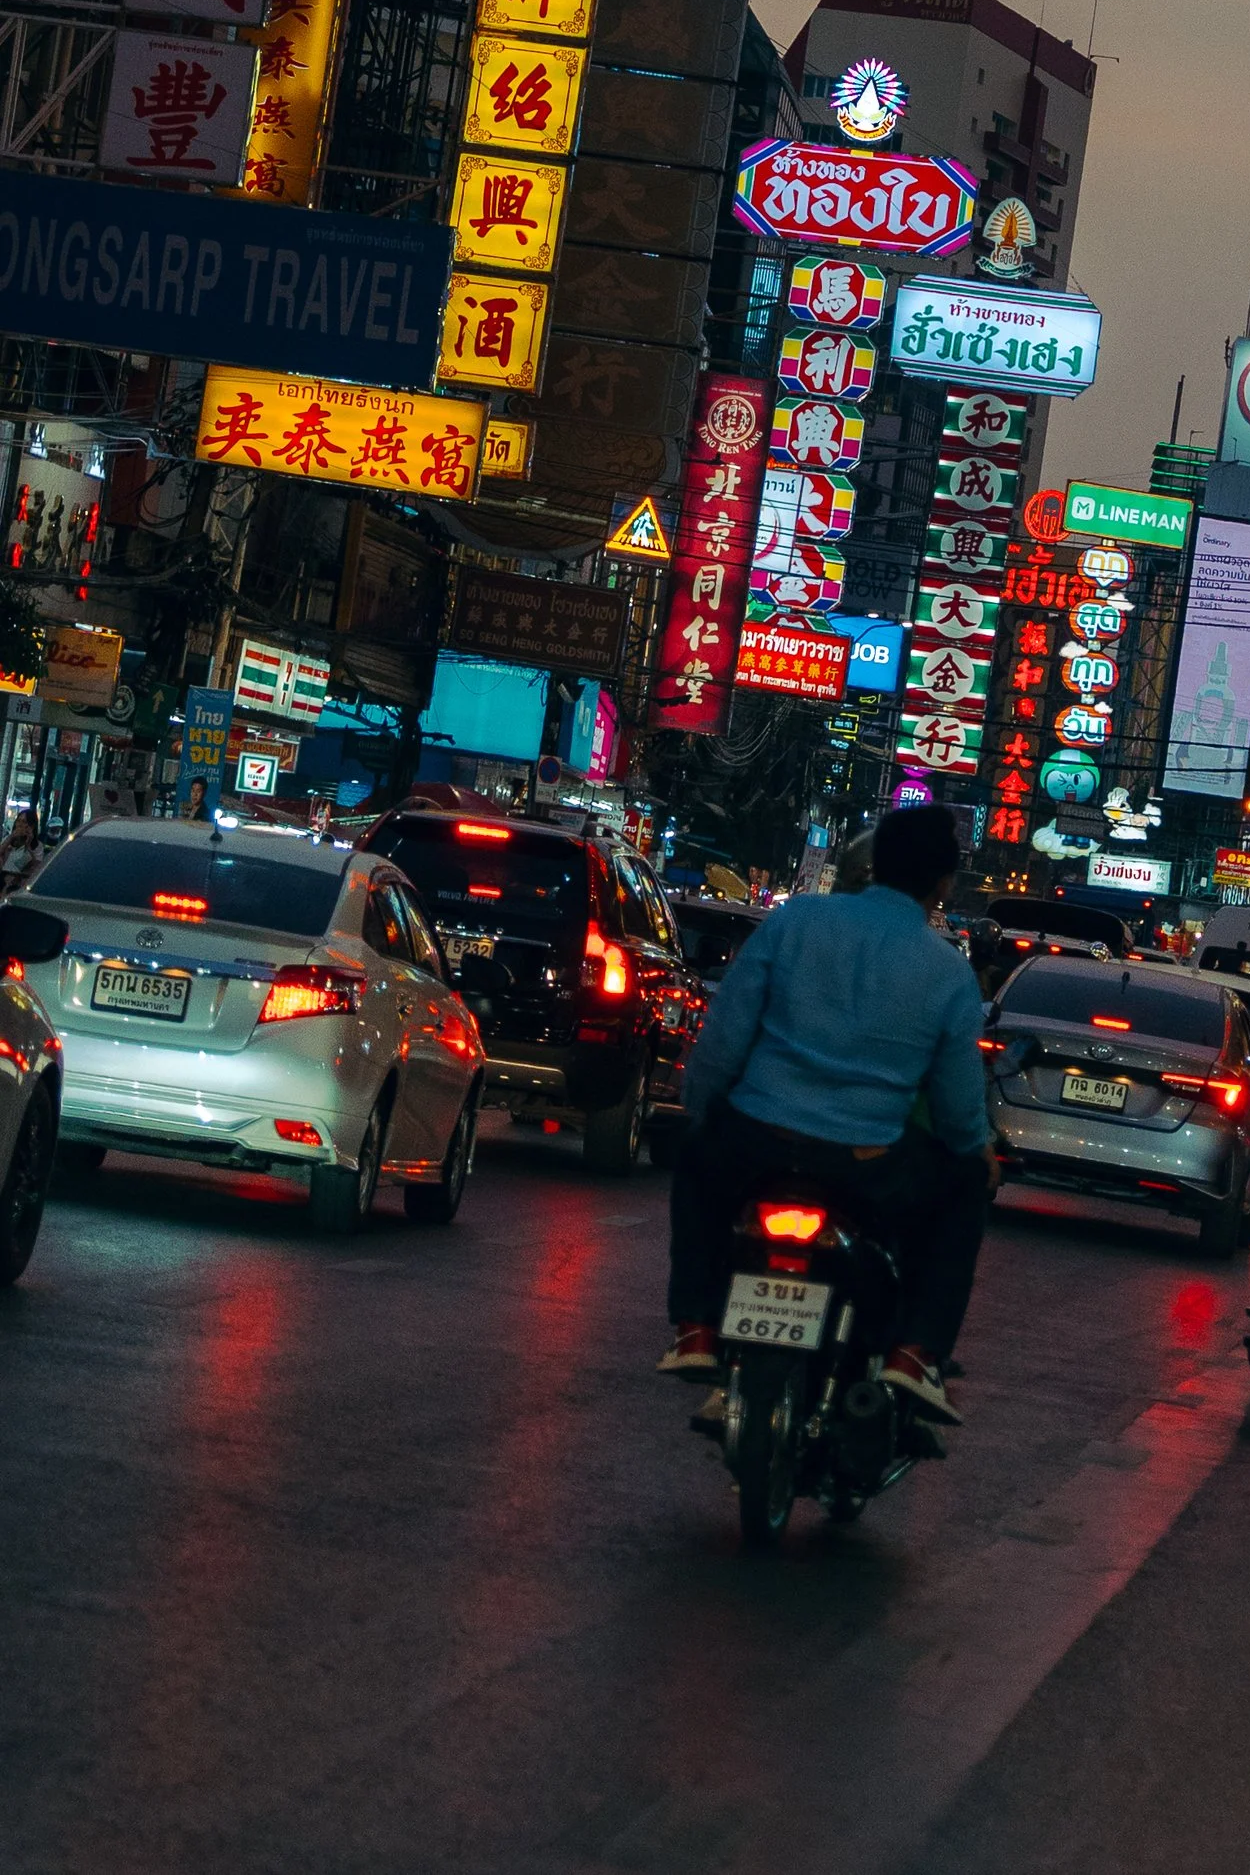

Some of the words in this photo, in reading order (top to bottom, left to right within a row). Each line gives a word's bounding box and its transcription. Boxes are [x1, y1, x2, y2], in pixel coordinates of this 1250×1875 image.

[771, 147, 867, 183] ห้างทอง
[763, 169, 952, 238] ทองใบ
[243, 243, 421, 345] TRAVEL
[947, 298, 1046, 329] ห้างขายทอง
[900, 304, 1083, 379] ฮั่วเซ่งเฮง
[277, 379, 415, 417] เอกไทยรังนก
[718, 442, 740, 455] REN
[741, 429, 764, 451] TANG
[675, 462, 742, 706] 北京同仁堂
[916, 401, 1007, 762] 和成興大金行
[1079, 605, 1121, 636] สุด
[459, 628, 475, 641] SO
[479, 630, 508, 647] SENG
[511, 637, 543, 653] HENG
[546, 642, 611, 663] GOLDSMITH
[1063, 705, 1107, 742] วัน
[453, 942, 490, 959] 5232
[100, 971, 138, 993] 5กน
[141, 978, 185, 1000] 6535
[107, 995, 170, 1012] กรุงเทพมหานคร
[1094, 1082, 1124, 1098] 6014
[736, 1317, 805, 1342] 6676
